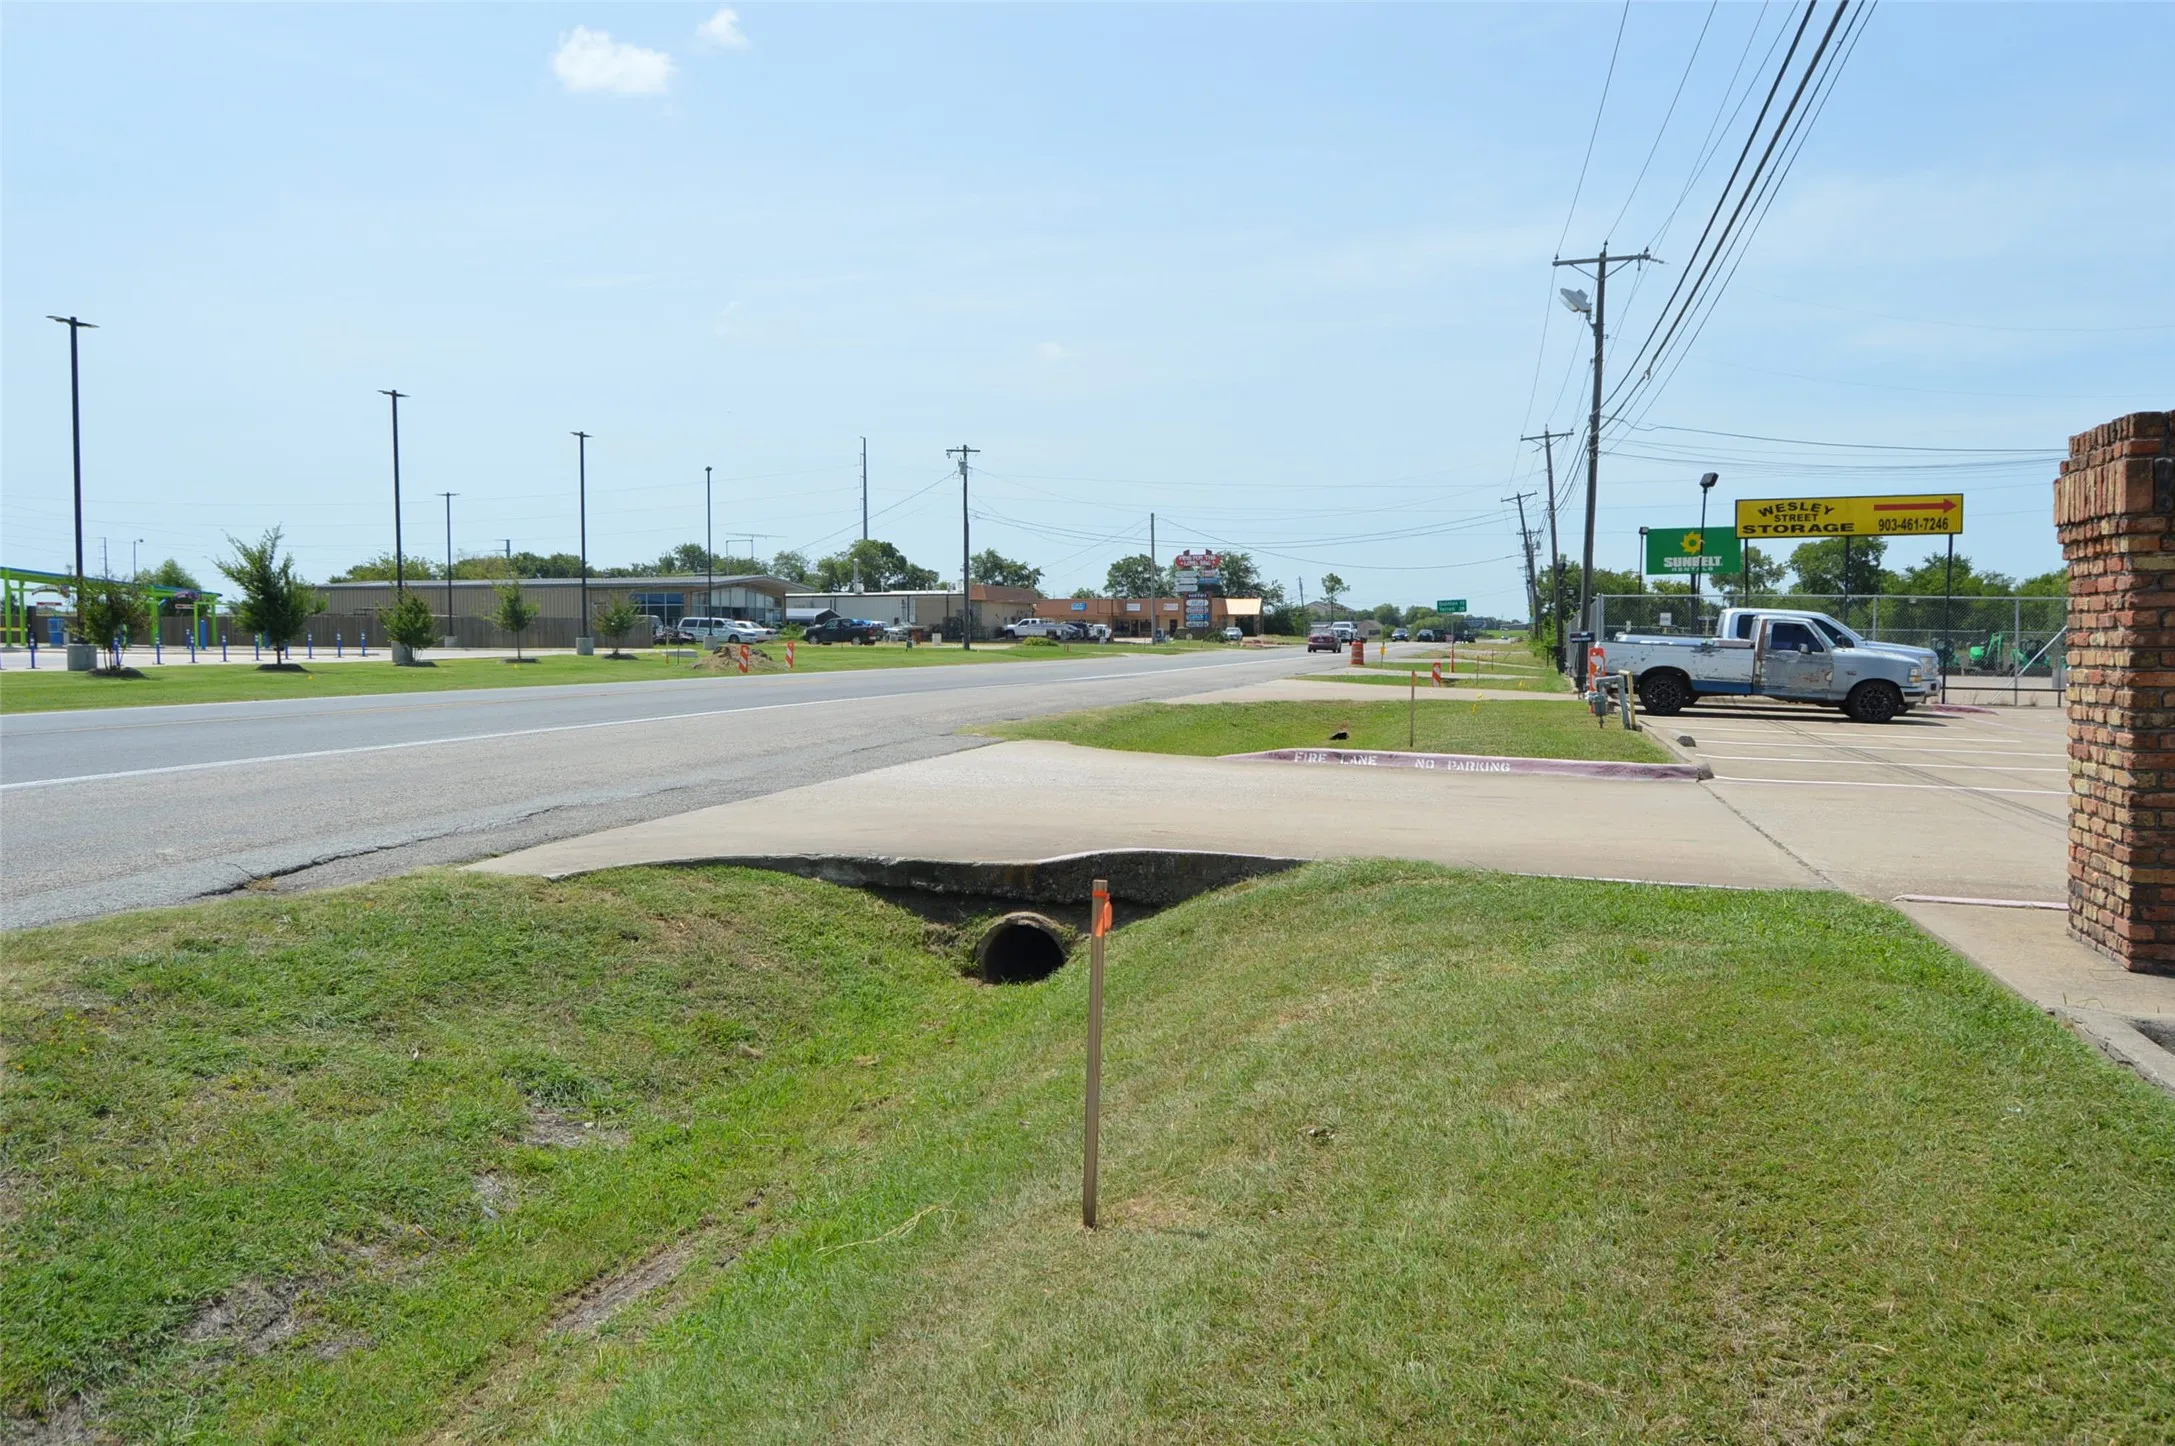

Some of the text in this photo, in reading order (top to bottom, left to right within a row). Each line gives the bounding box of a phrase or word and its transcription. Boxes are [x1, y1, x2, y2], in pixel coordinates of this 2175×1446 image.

[1758, 502, 1834, 517] WESLEY
[1774, 513, 1818, 522] STREET
[1878, 517, 1949, 531] 903-461-7246
[1742, 523, 1855, 534] STORAGE
[1663, 555, 1722, 568] SUNBELT
[1294, 752, 1511, 772] FIRE LANE NO PARKING
